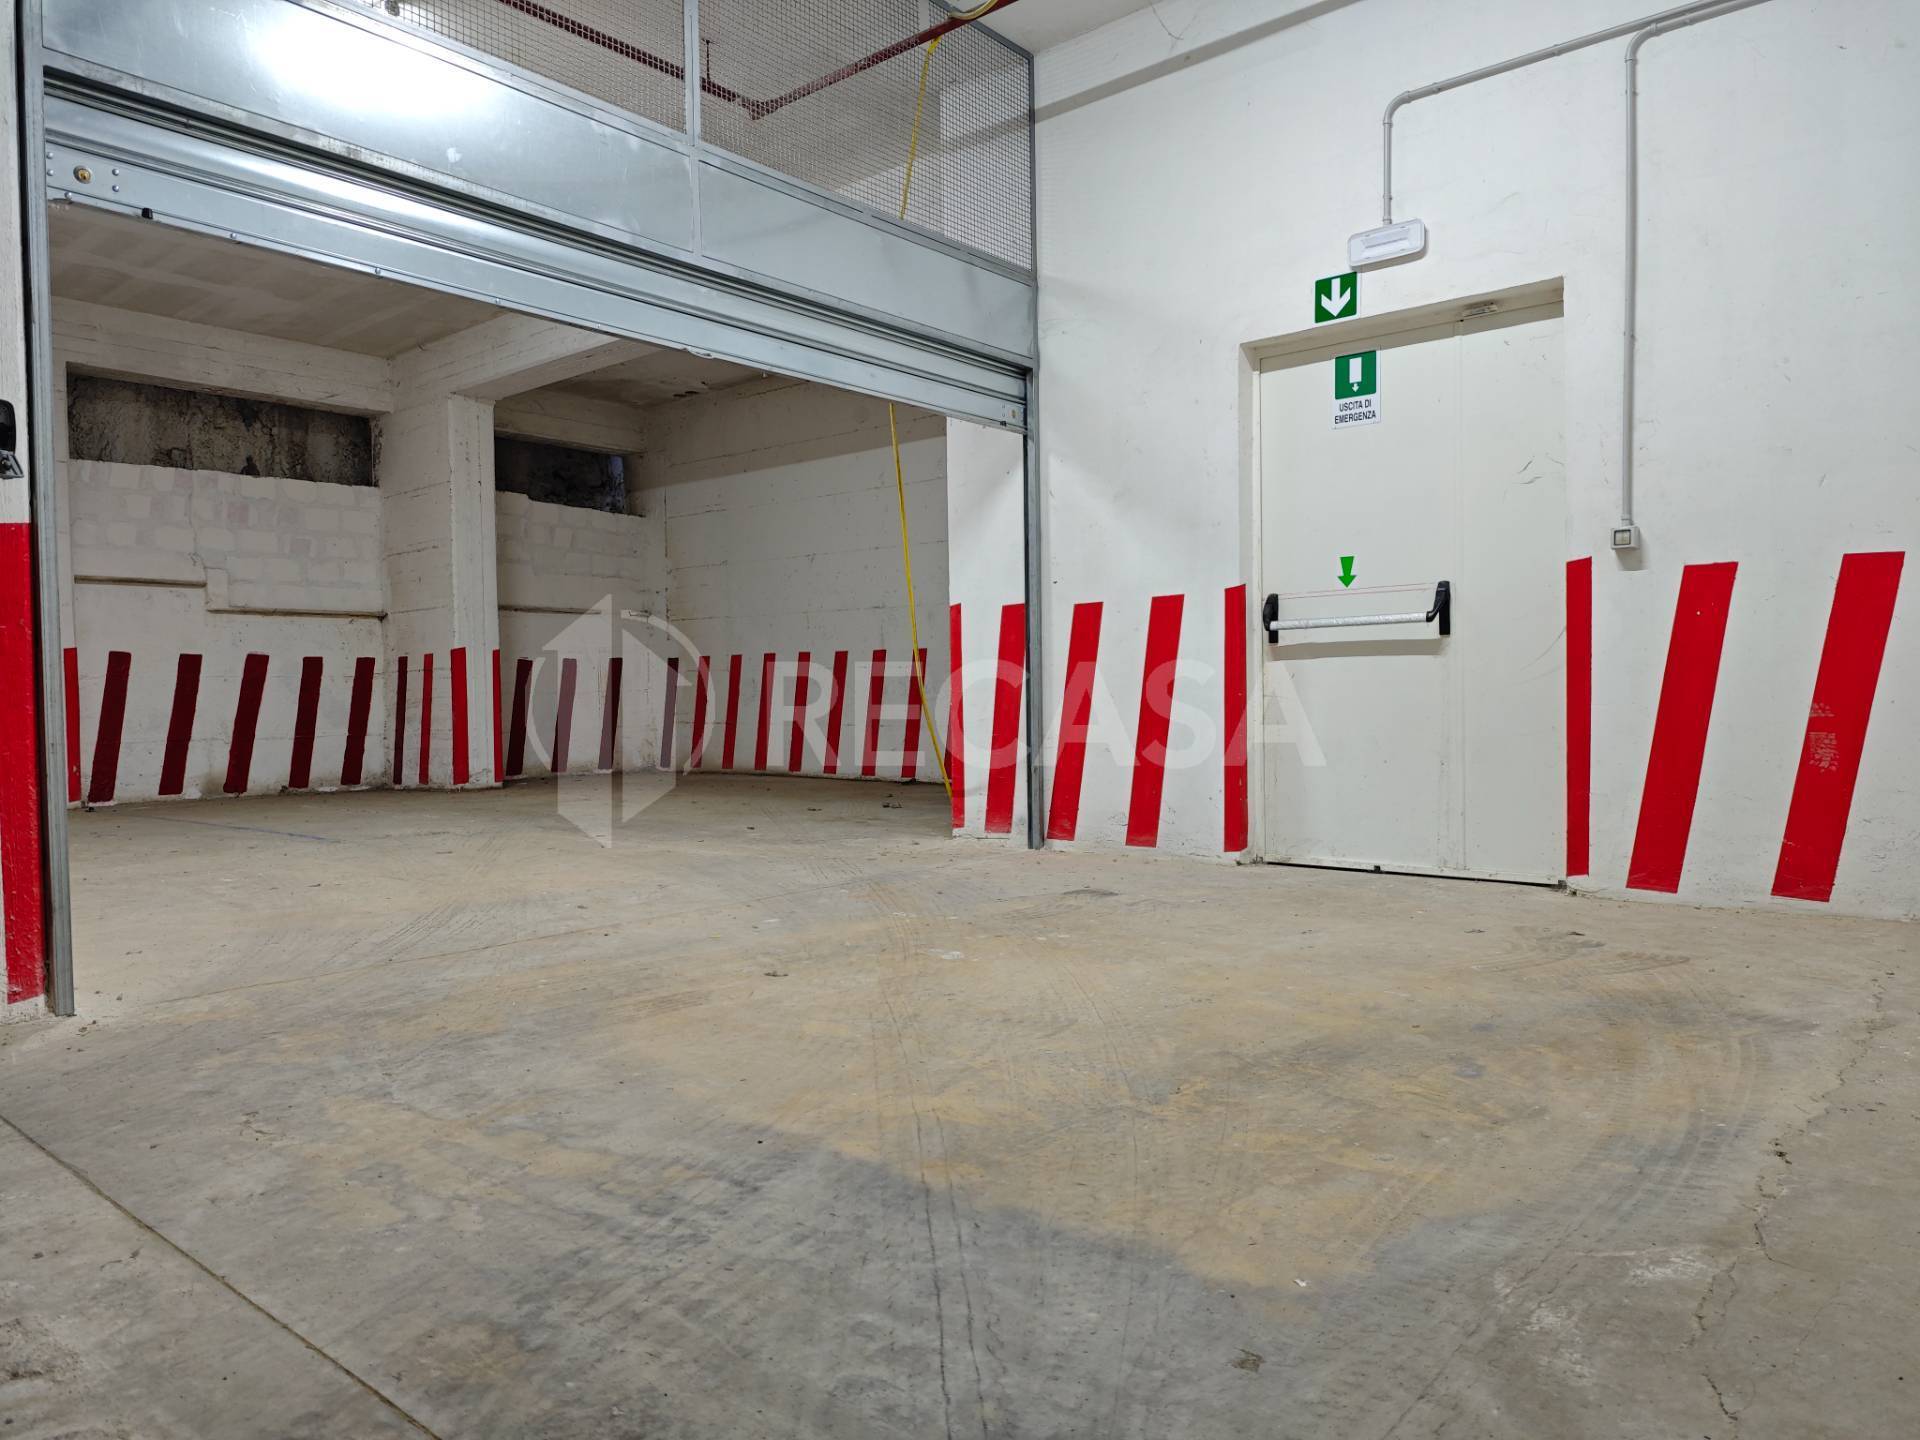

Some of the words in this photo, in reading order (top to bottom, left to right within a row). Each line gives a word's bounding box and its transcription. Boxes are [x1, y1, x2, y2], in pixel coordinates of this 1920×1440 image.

[1339, 400, 1363, 412] USCITA
[1364, 399, 1372, 409] DI
[1334, 410, 1376, 424] EMERGENZA
